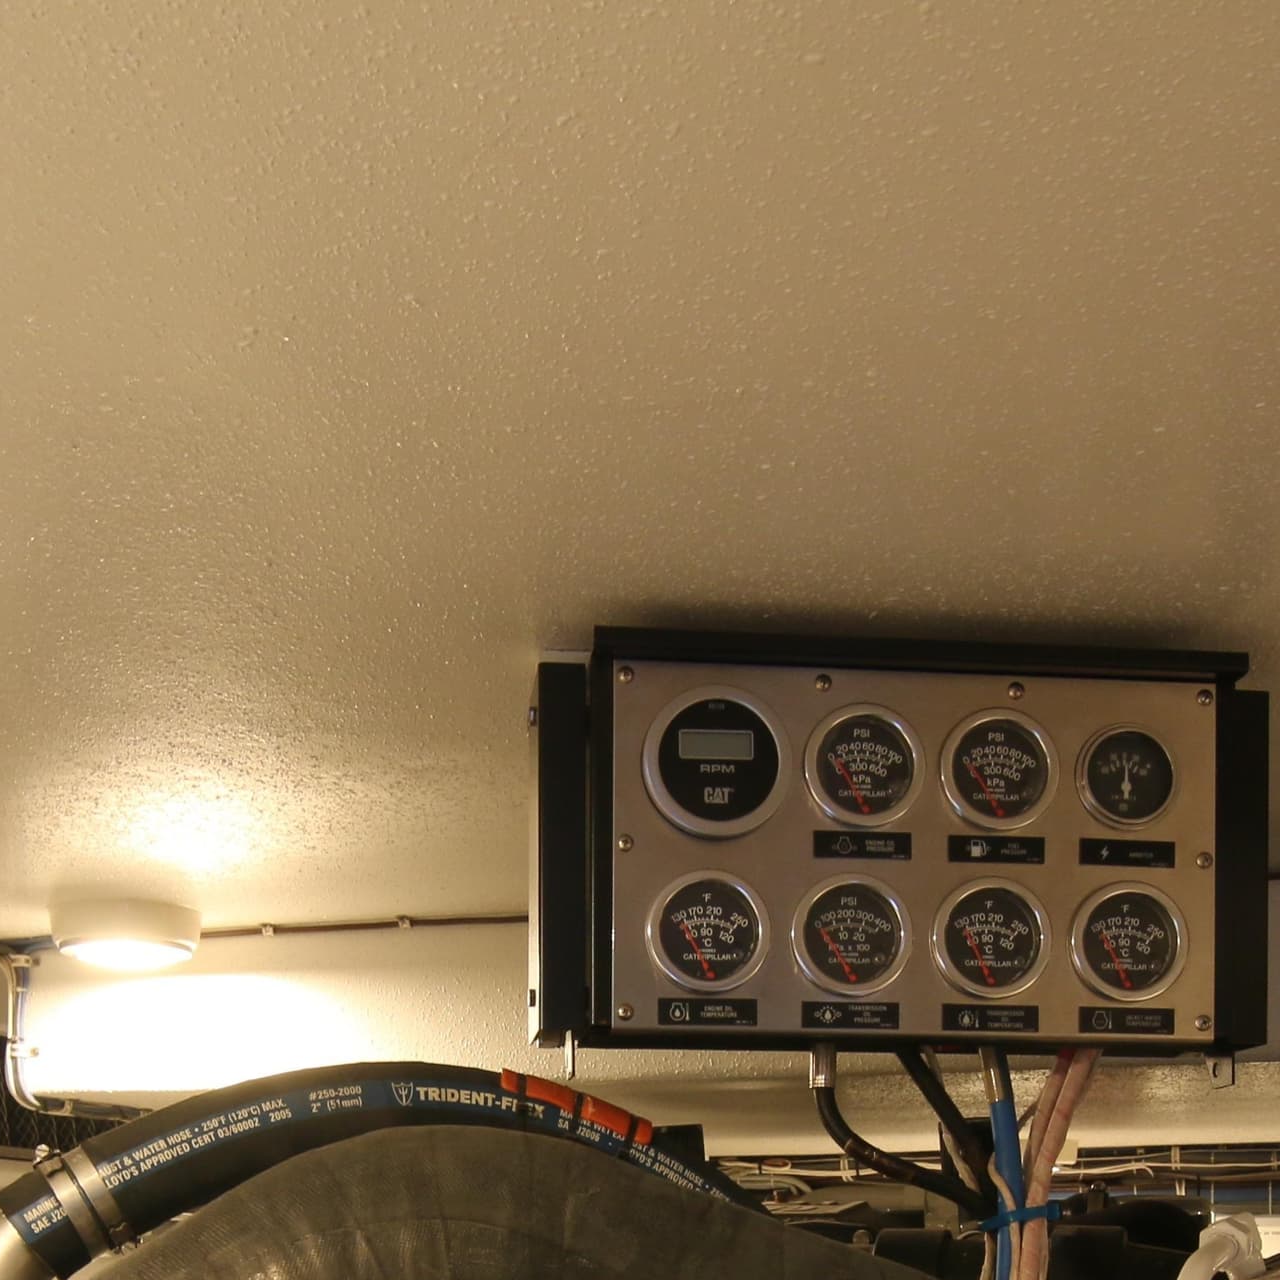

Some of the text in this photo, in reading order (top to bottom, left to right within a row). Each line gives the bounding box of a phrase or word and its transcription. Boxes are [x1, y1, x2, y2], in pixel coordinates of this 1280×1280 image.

[853, 728, 871, 738] PSI
[988, 732, 1005, 742] PSI
[827, 752, 835, 761] 0
[849, 742, 861, 750] 40
[862, 742, 875, 751] 60
[875, 744, 888, 755] 80
[888, 750, 903, 764] 100
[962, 756, 970, 765] 0
[984, 745, 996, 754] 40
[996, 746, 1009, 755] 60
[1009, 748, 1022, 759] 80
[1022, 754, 1036, 768] 100
[700, 764, 735, 774] RPM
[849, 762, 888, 777] 300 600
[984, 765, 1021, 781] 300 600
[852, 774, 871, 784] kPa
[986, 778, 1005, 787] kPa
[703, 787, 730, 804] CAT
[841, 897, 857, 906] PSI
[671, 906, 749, 928] 130 170 210 250
[815, 909, 891, 932] 0 100 200 300 400
[970, 913, 986, 922] 170
[987, 913, 1004, 922] 210
[1107, 917, 1121, 926] 170
[1124, 917, 1140, 926] 210
[701, 928, 735, 944] 90 120
[838, 932, 865, 941] 10 20
[981, 935, 1014, 950] 90 120
[1119, 938, 1150, 954] 90 120
[308, 1085, 362, 1101] #250-2000
[311, 1097, 363, 1113] 2" (51mm)
[124, 1155, 133, 1166] &
[133, 1138, 168, 1161] WATER
[167, 1128, 193, 1150] HOSE
[201, 1115, 228, 1132] 250°F
[229, 1105, 261, 1125] (120°C)
[140, 1143, 190, 1176] APPROVED
[191, 1132, 217, 1150] CERT
[217, 1118, 261, 1138] 03/60002
[269, 1108, 293, 1123] 2005
[657, 1152, 684, 1173] WATER
[684, 1169, 705, 1187] HOSE
[23, 1196, 59, 1223] MARINE
[30, 1216, 51, 1234] SAE
